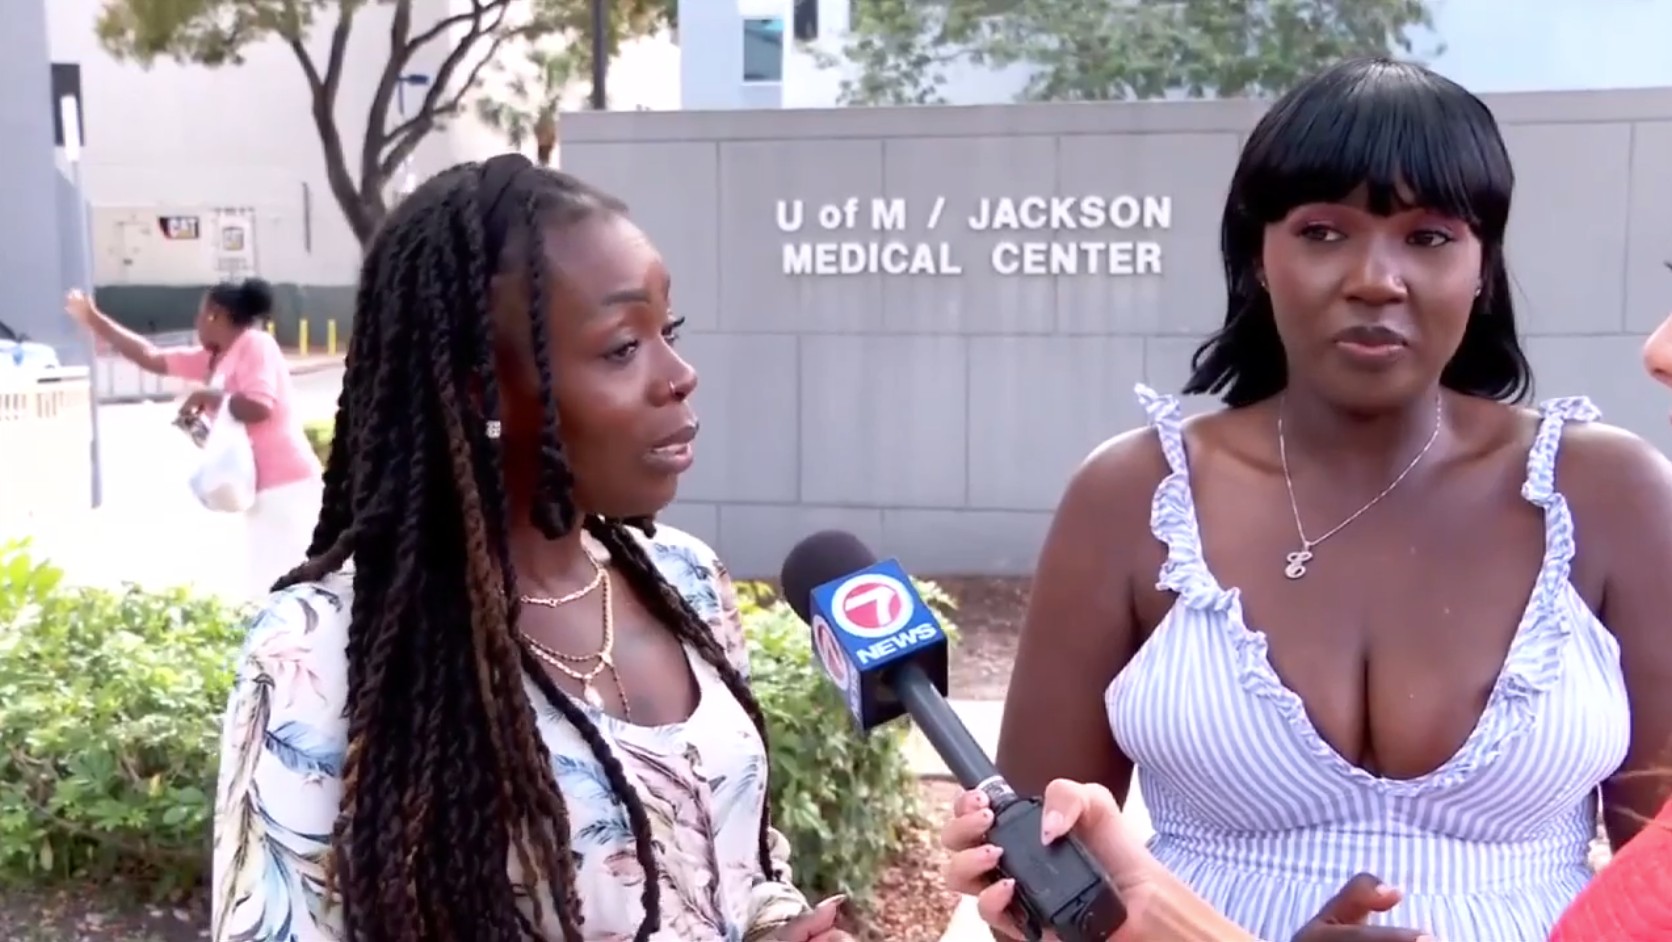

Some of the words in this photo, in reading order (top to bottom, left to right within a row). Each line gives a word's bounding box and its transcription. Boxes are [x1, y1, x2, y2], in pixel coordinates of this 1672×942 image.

[776, 199, 804, 232] U
[818, 197, 860, 230] of
[871, 198, 906, 231] M
[927, 196, 946, 229] /
[967, 195, 1172, 230] JACKSON
[782, 241, 962, 275] MEDICAL
[991, 241, 1163, 275] CENTER
[844, 586, 898, 627] 7
[856, 623, 938, 666] NEWS
